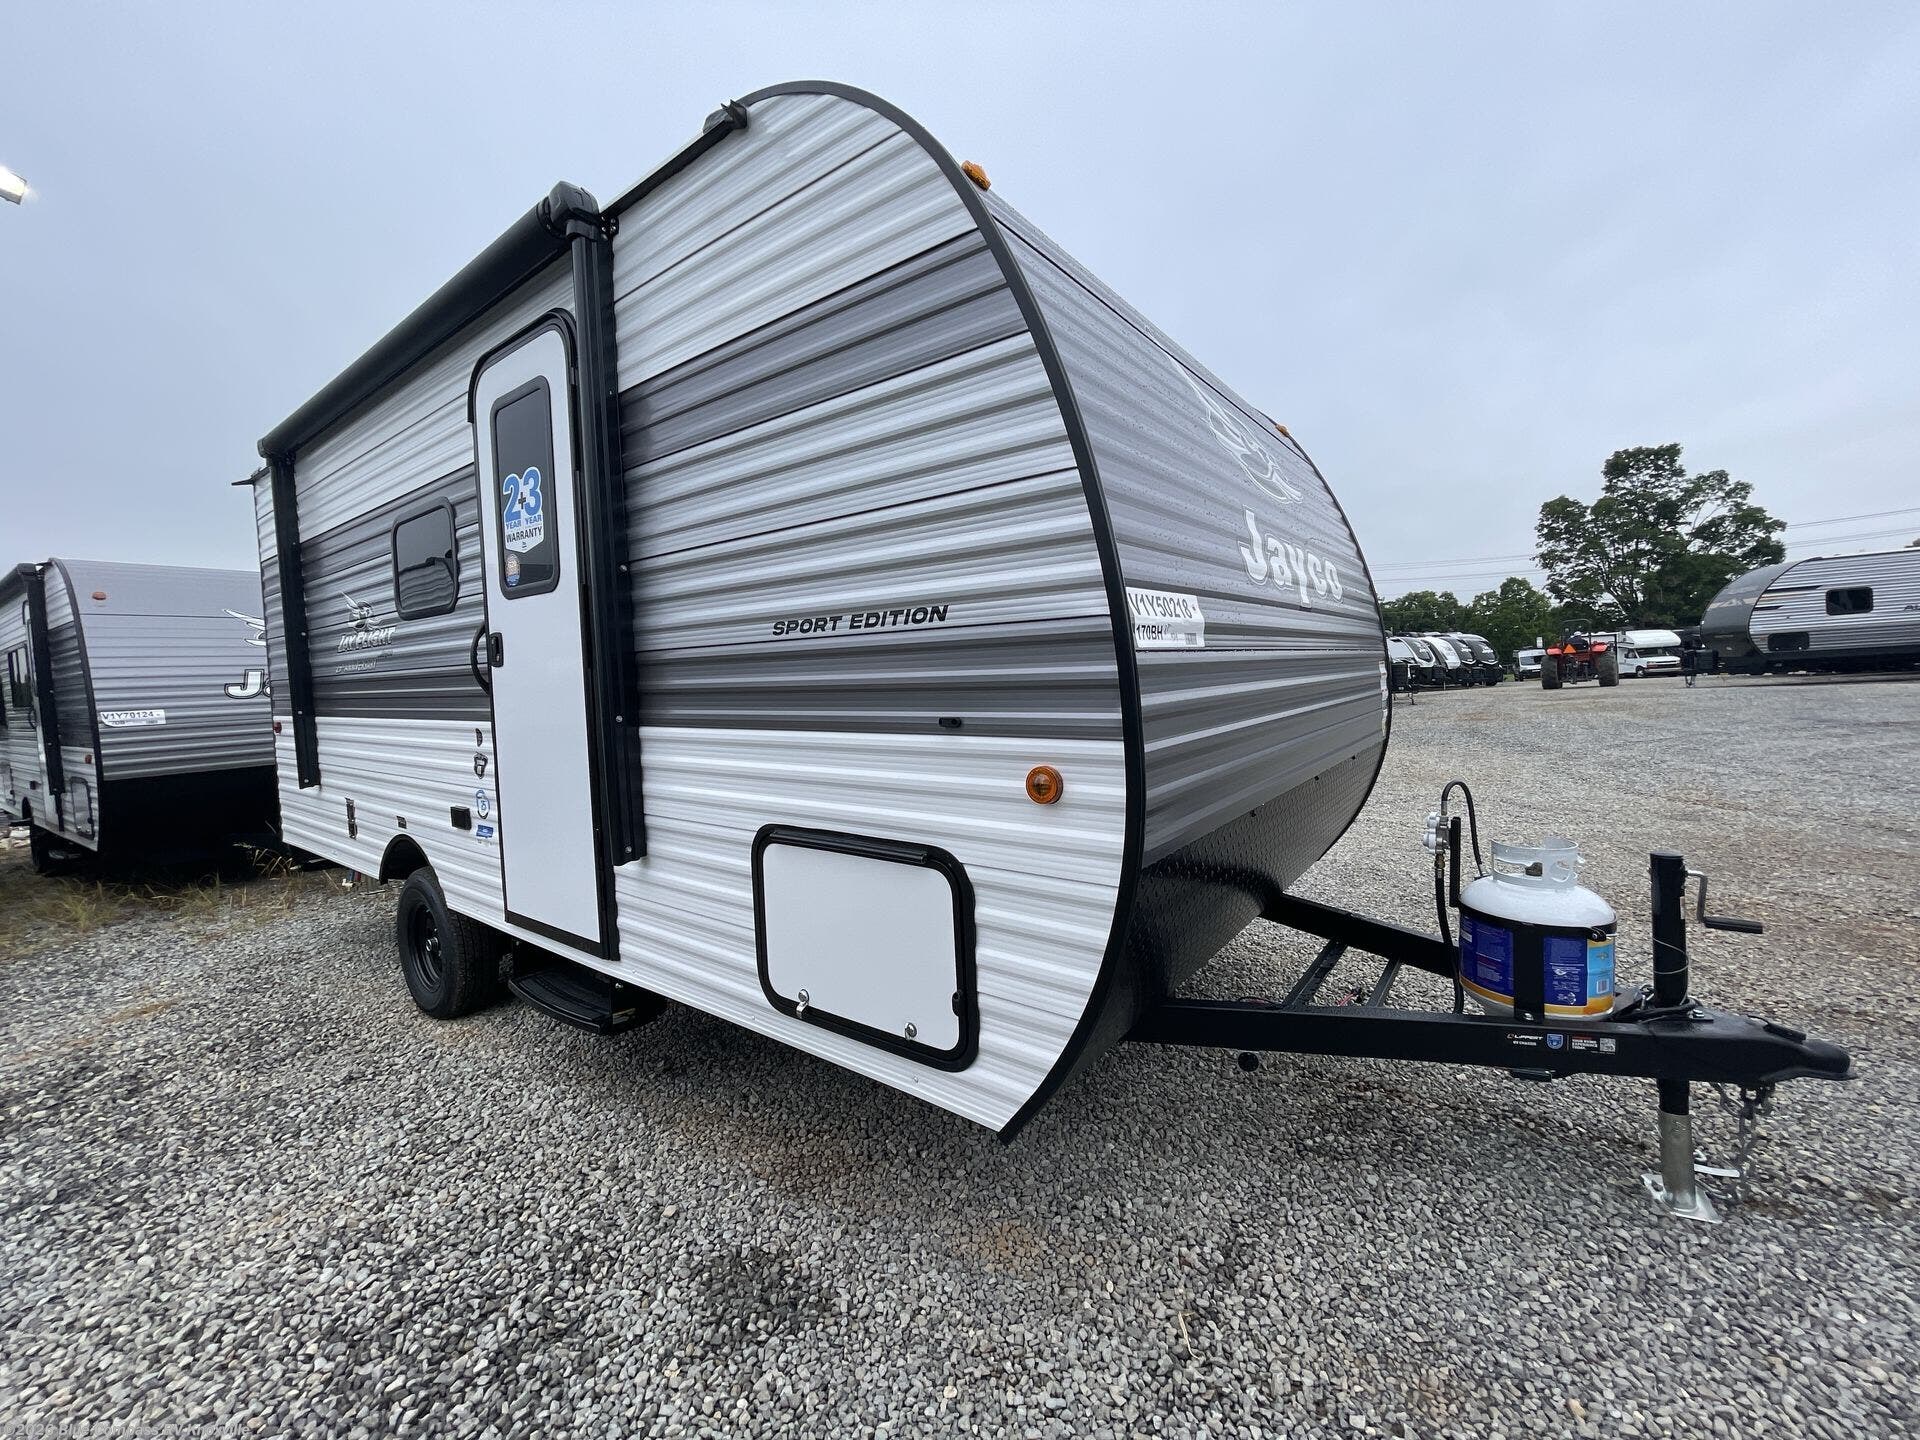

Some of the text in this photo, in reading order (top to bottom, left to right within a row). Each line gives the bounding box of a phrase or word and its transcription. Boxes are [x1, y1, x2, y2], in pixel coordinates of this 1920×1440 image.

[506, 514, 542, 530] YEAR YEAR
[506, 526, 543, 543] WARRANTY
[1238, 505, 1344, 608] Jayco
[772, 604, 950, 637] SPORT EDITION
[356, 627, 396, 649] FLIGHT
[1136, 624, 1164, 641] 170BH
